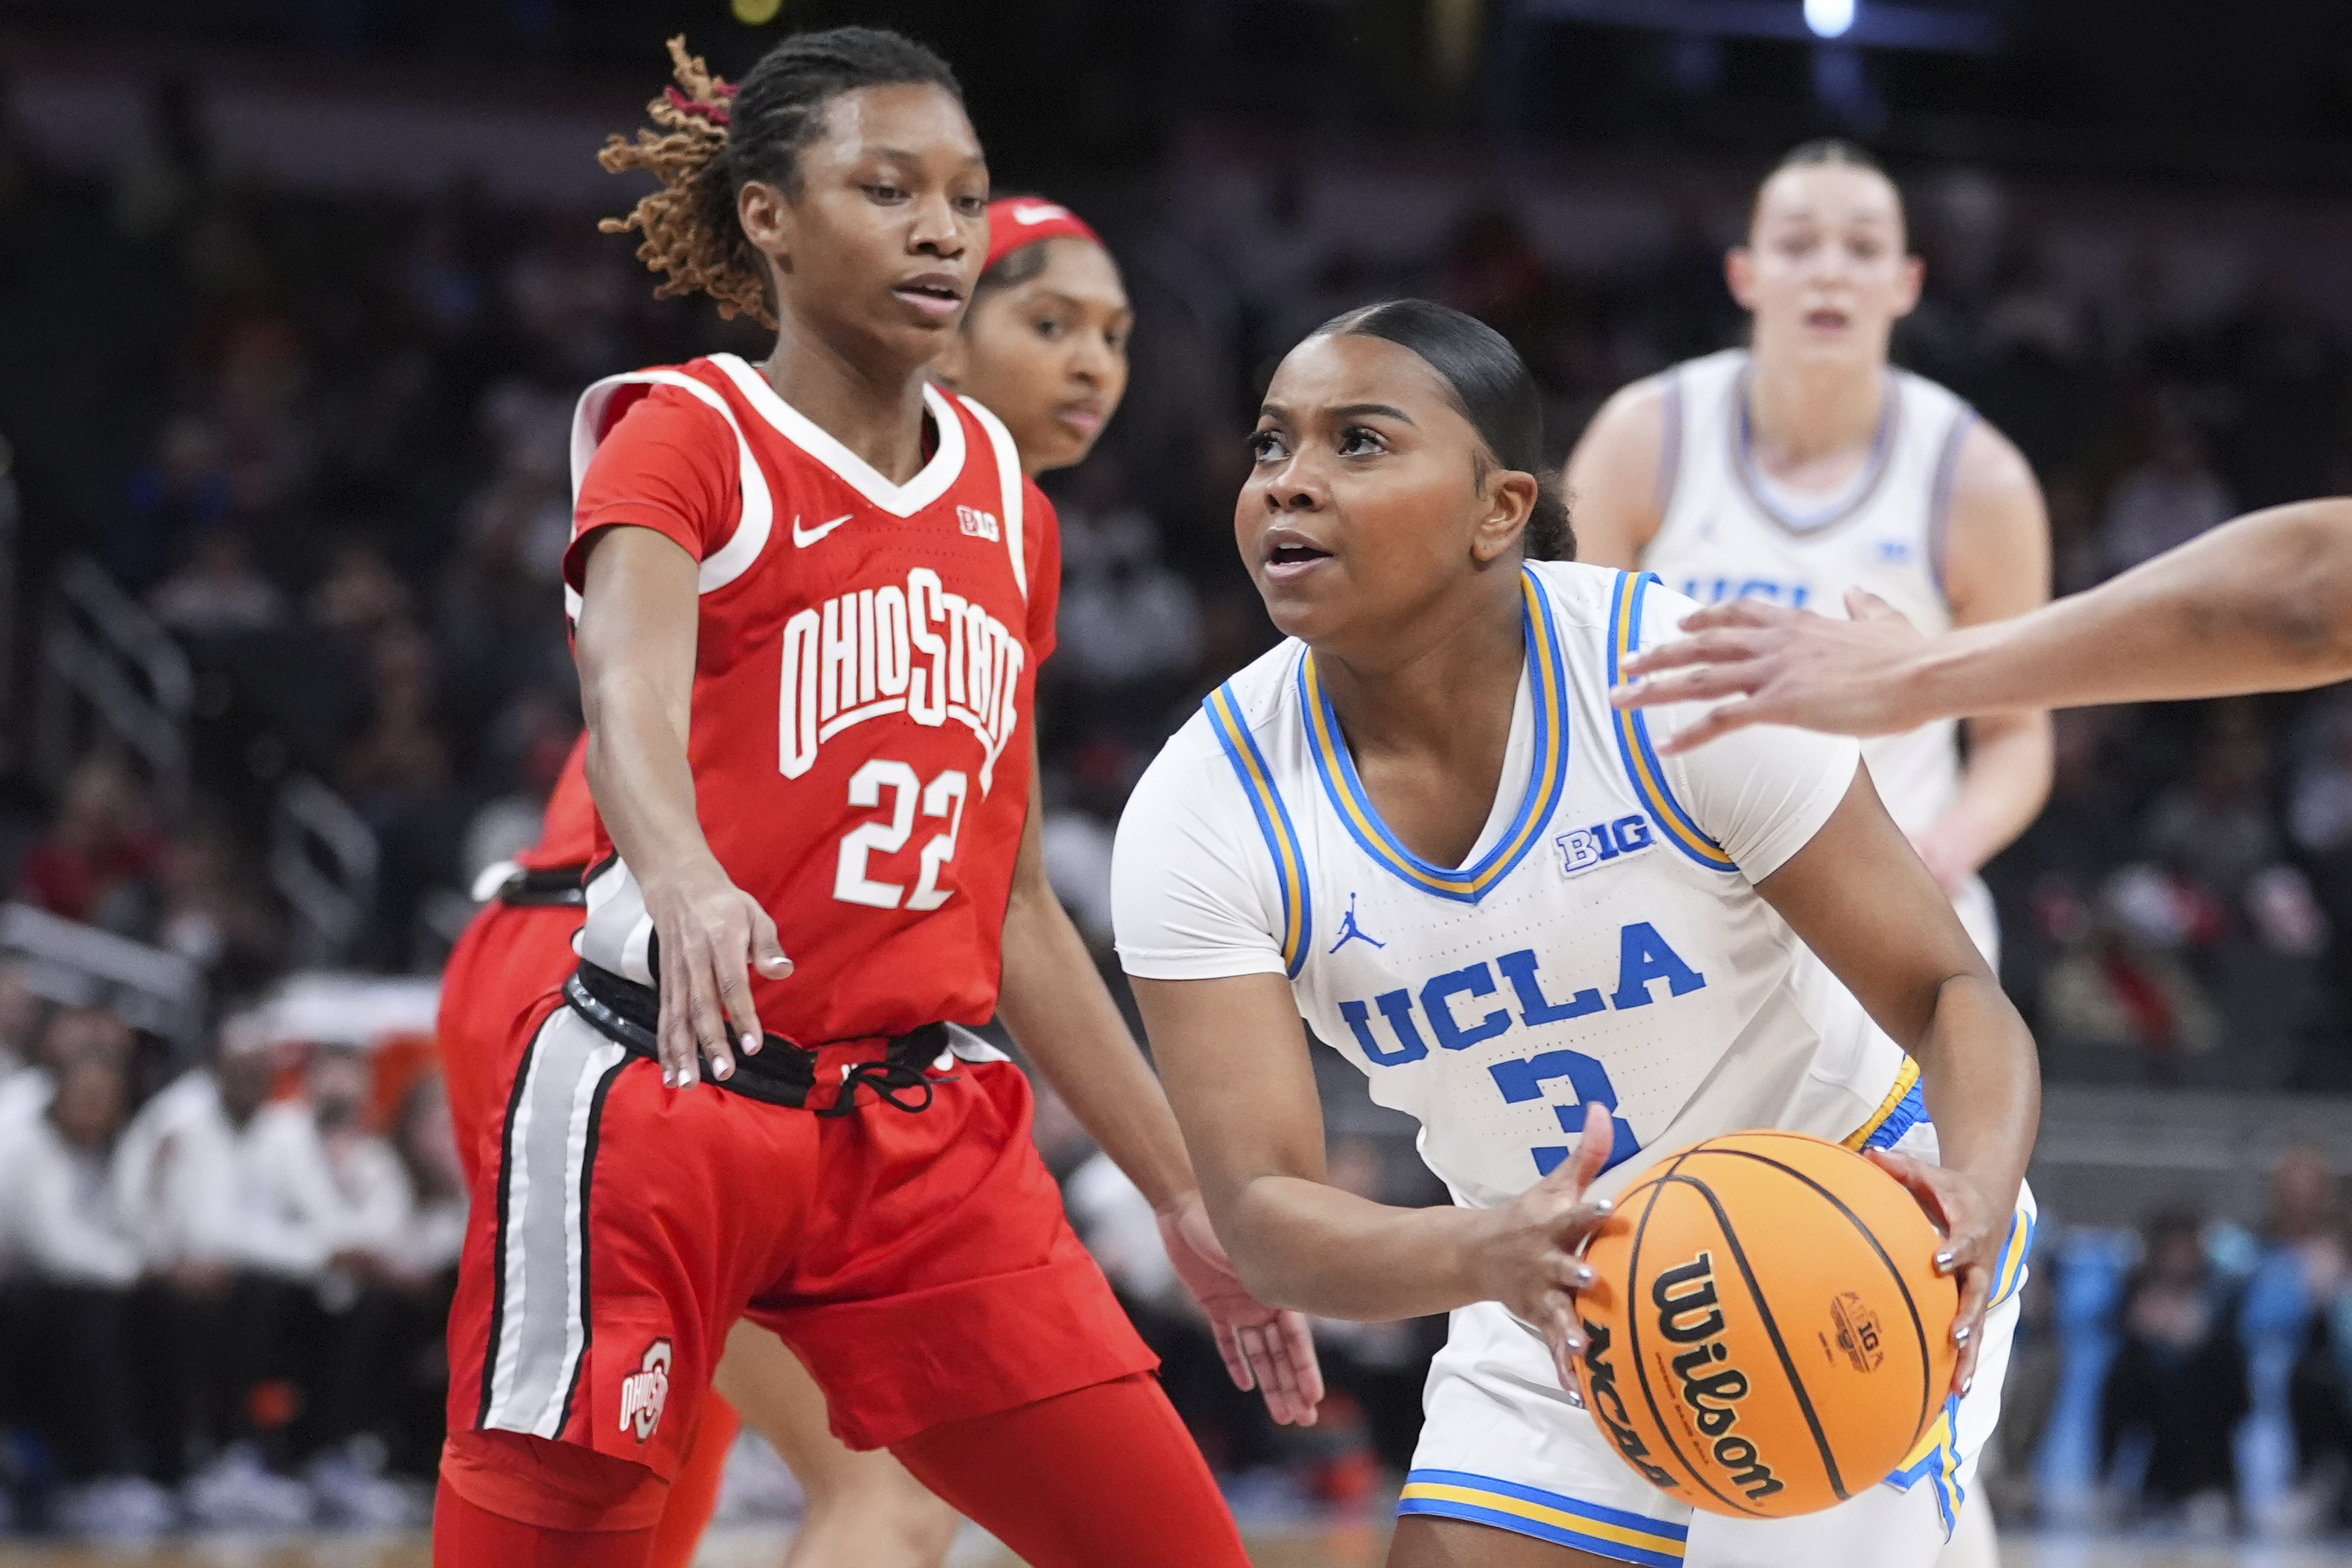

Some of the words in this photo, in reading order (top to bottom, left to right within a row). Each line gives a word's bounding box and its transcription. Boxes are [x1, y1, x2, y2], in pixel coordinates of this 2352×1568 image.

[833, 759, 967, 911] 22
[1338, 922, 1707, 1067] UCLA
[1487, 1049, 1642, 1178] 3
[1583, 1318, 1680, 1488] NCAA
[1652, 1249, 1784, 1500] Wilson
